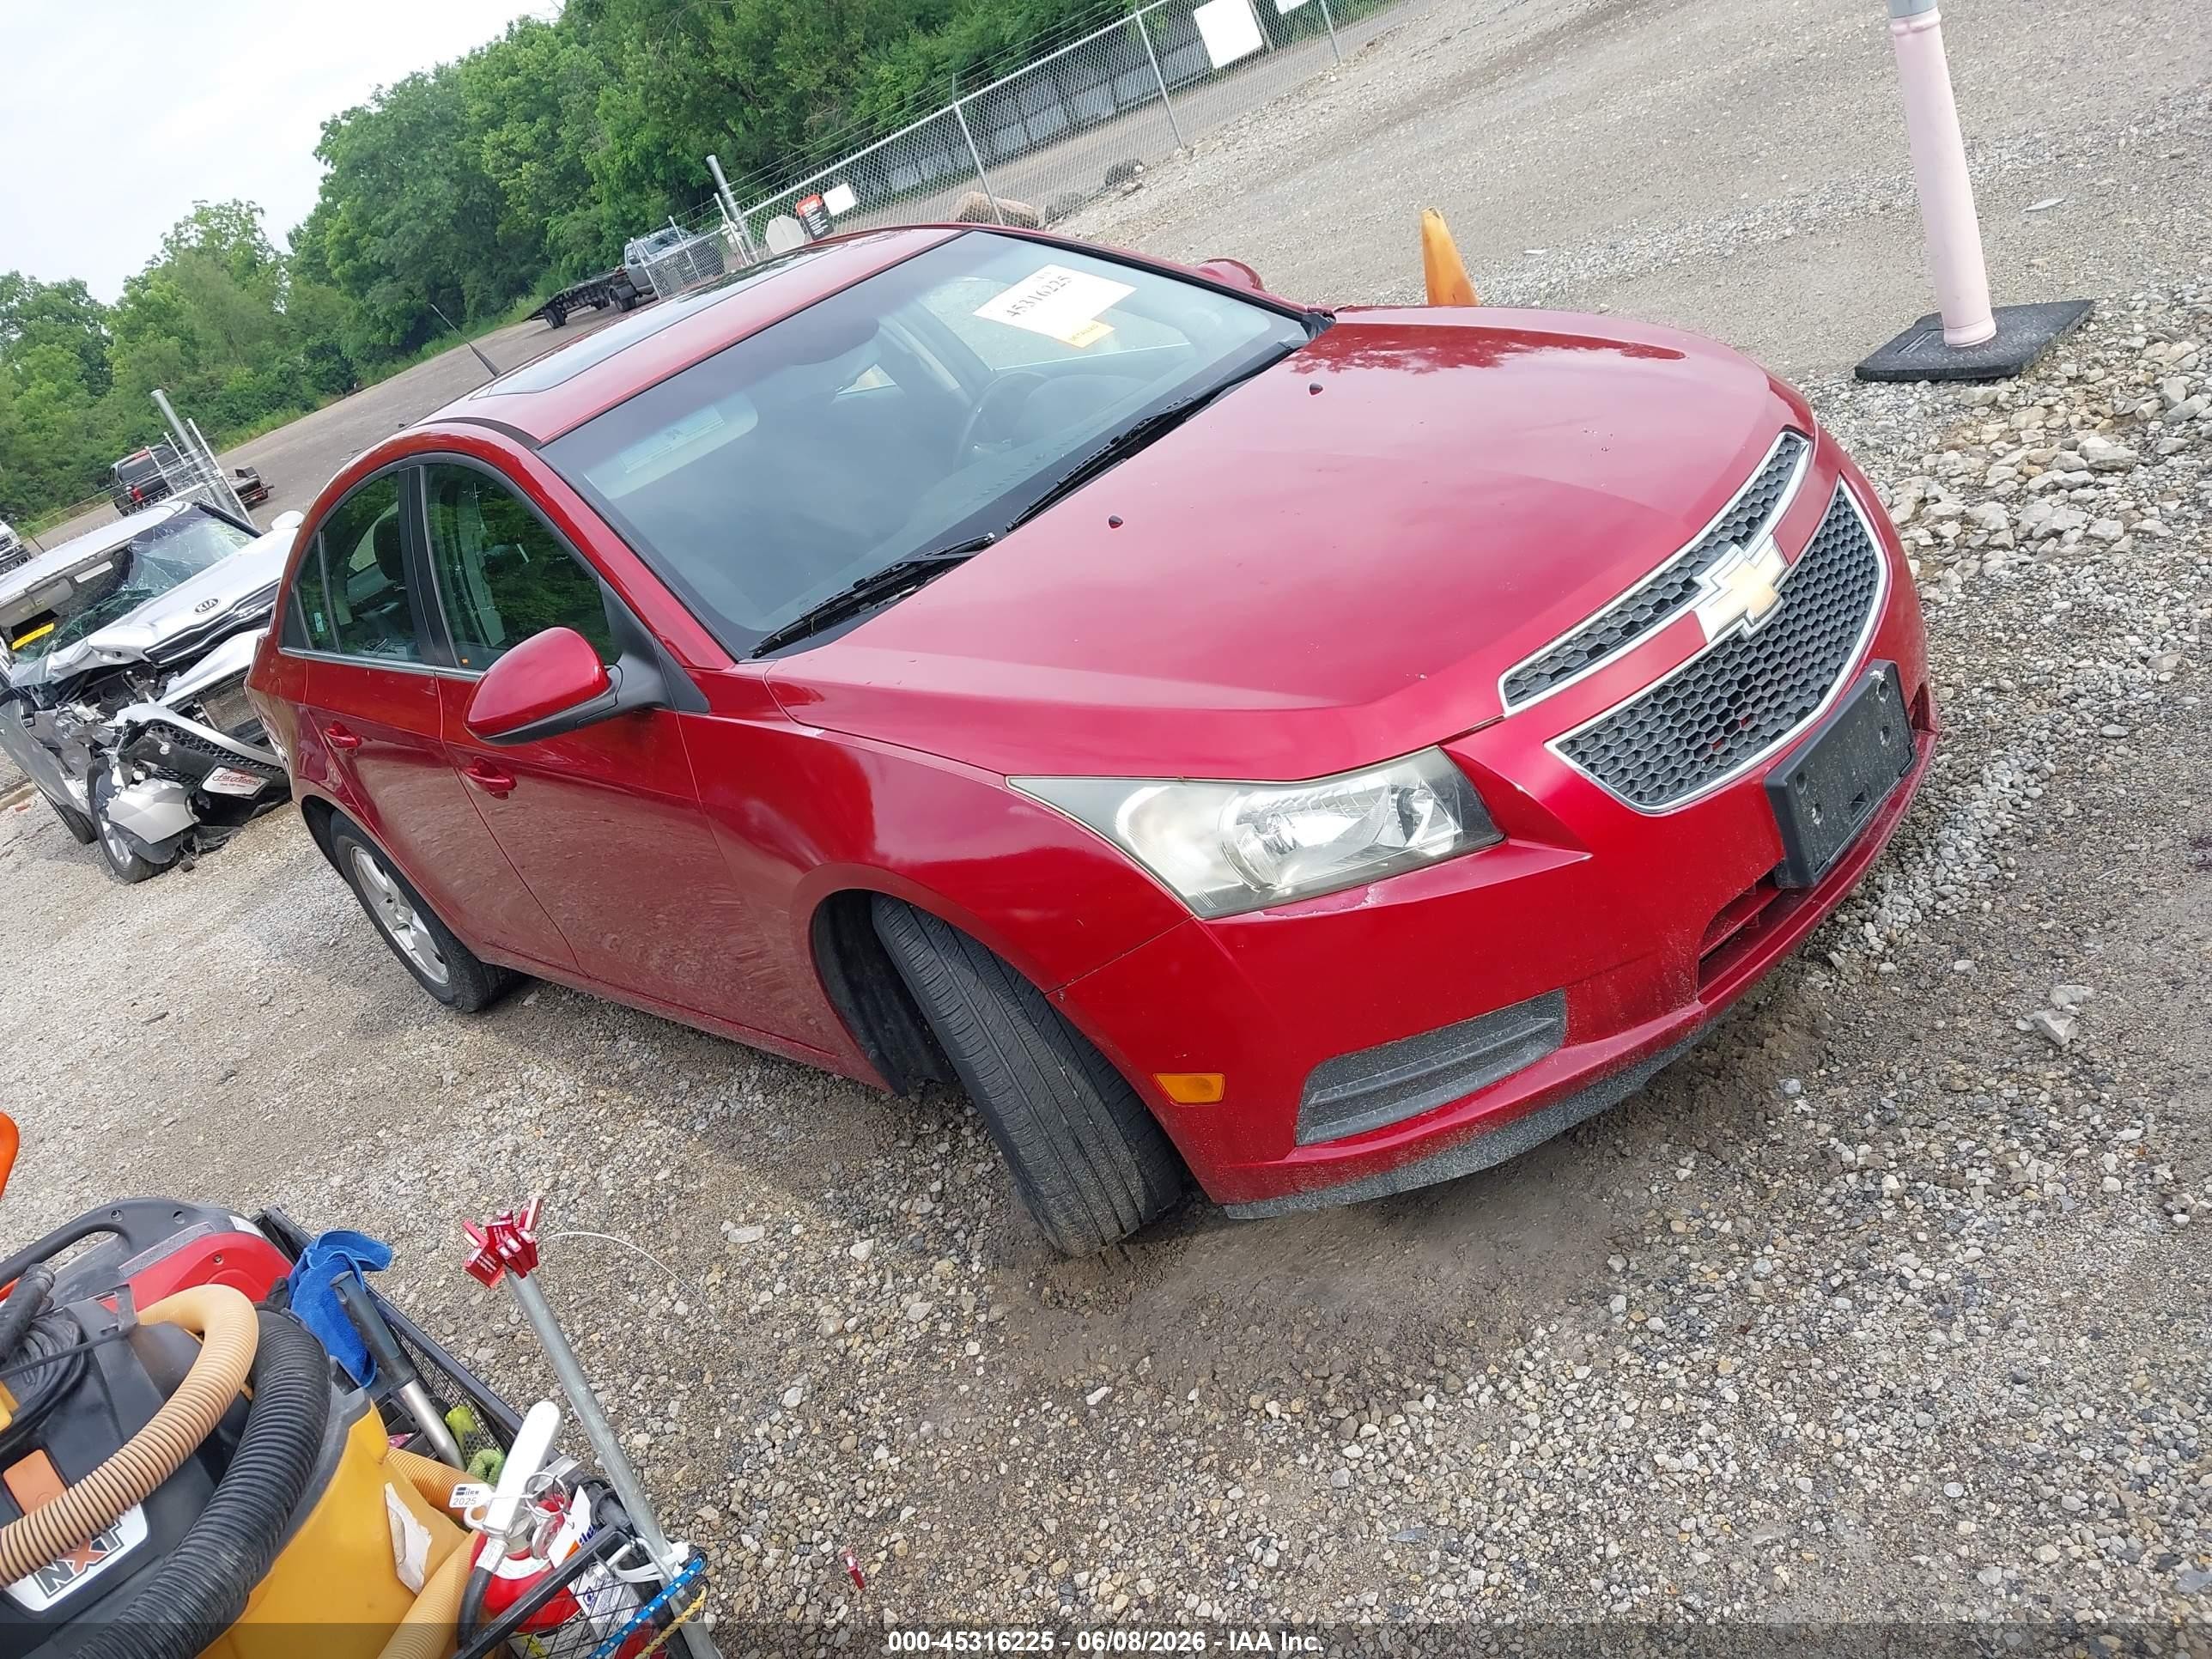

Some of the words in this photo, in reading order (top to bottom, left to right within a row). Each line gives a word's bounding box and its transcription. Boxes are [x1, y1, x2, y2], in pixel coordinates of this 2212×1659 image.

[1006, 276, 1073, 317] 45316225
[196, 599, 218, 612] KIA
[452, 1497, 477, 1505] 2025
[31, 1520, 125, 1599] NXT
